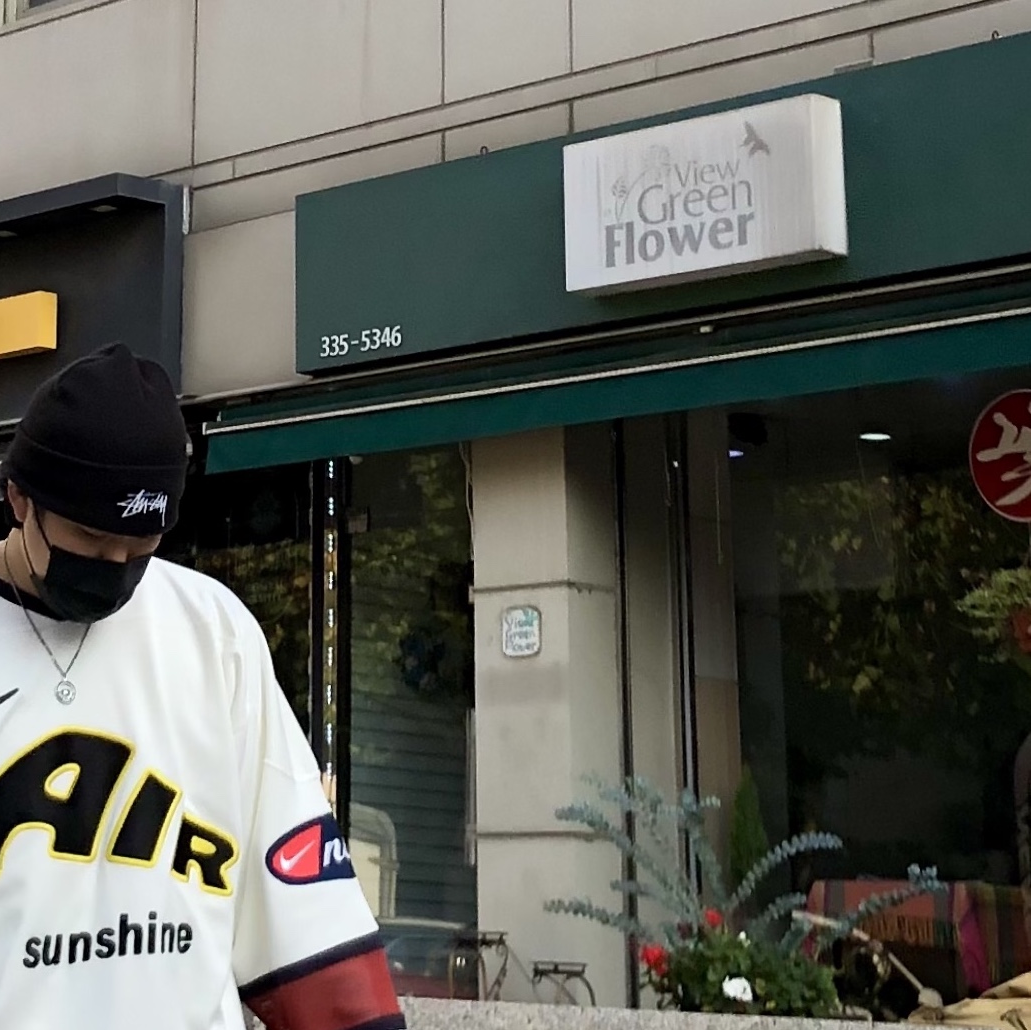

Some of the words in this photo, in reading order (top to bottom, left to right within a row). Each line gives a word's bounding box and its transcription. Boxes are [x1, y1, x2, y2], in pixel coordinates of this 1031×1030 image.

[675, 160, 740, 188] View
[637, 180, 753, 225] Green
[605, 212, 754, 268] Flower
[320, 325, 402, 357] 335-5346
[23, 911, 193, 968] sunshine
